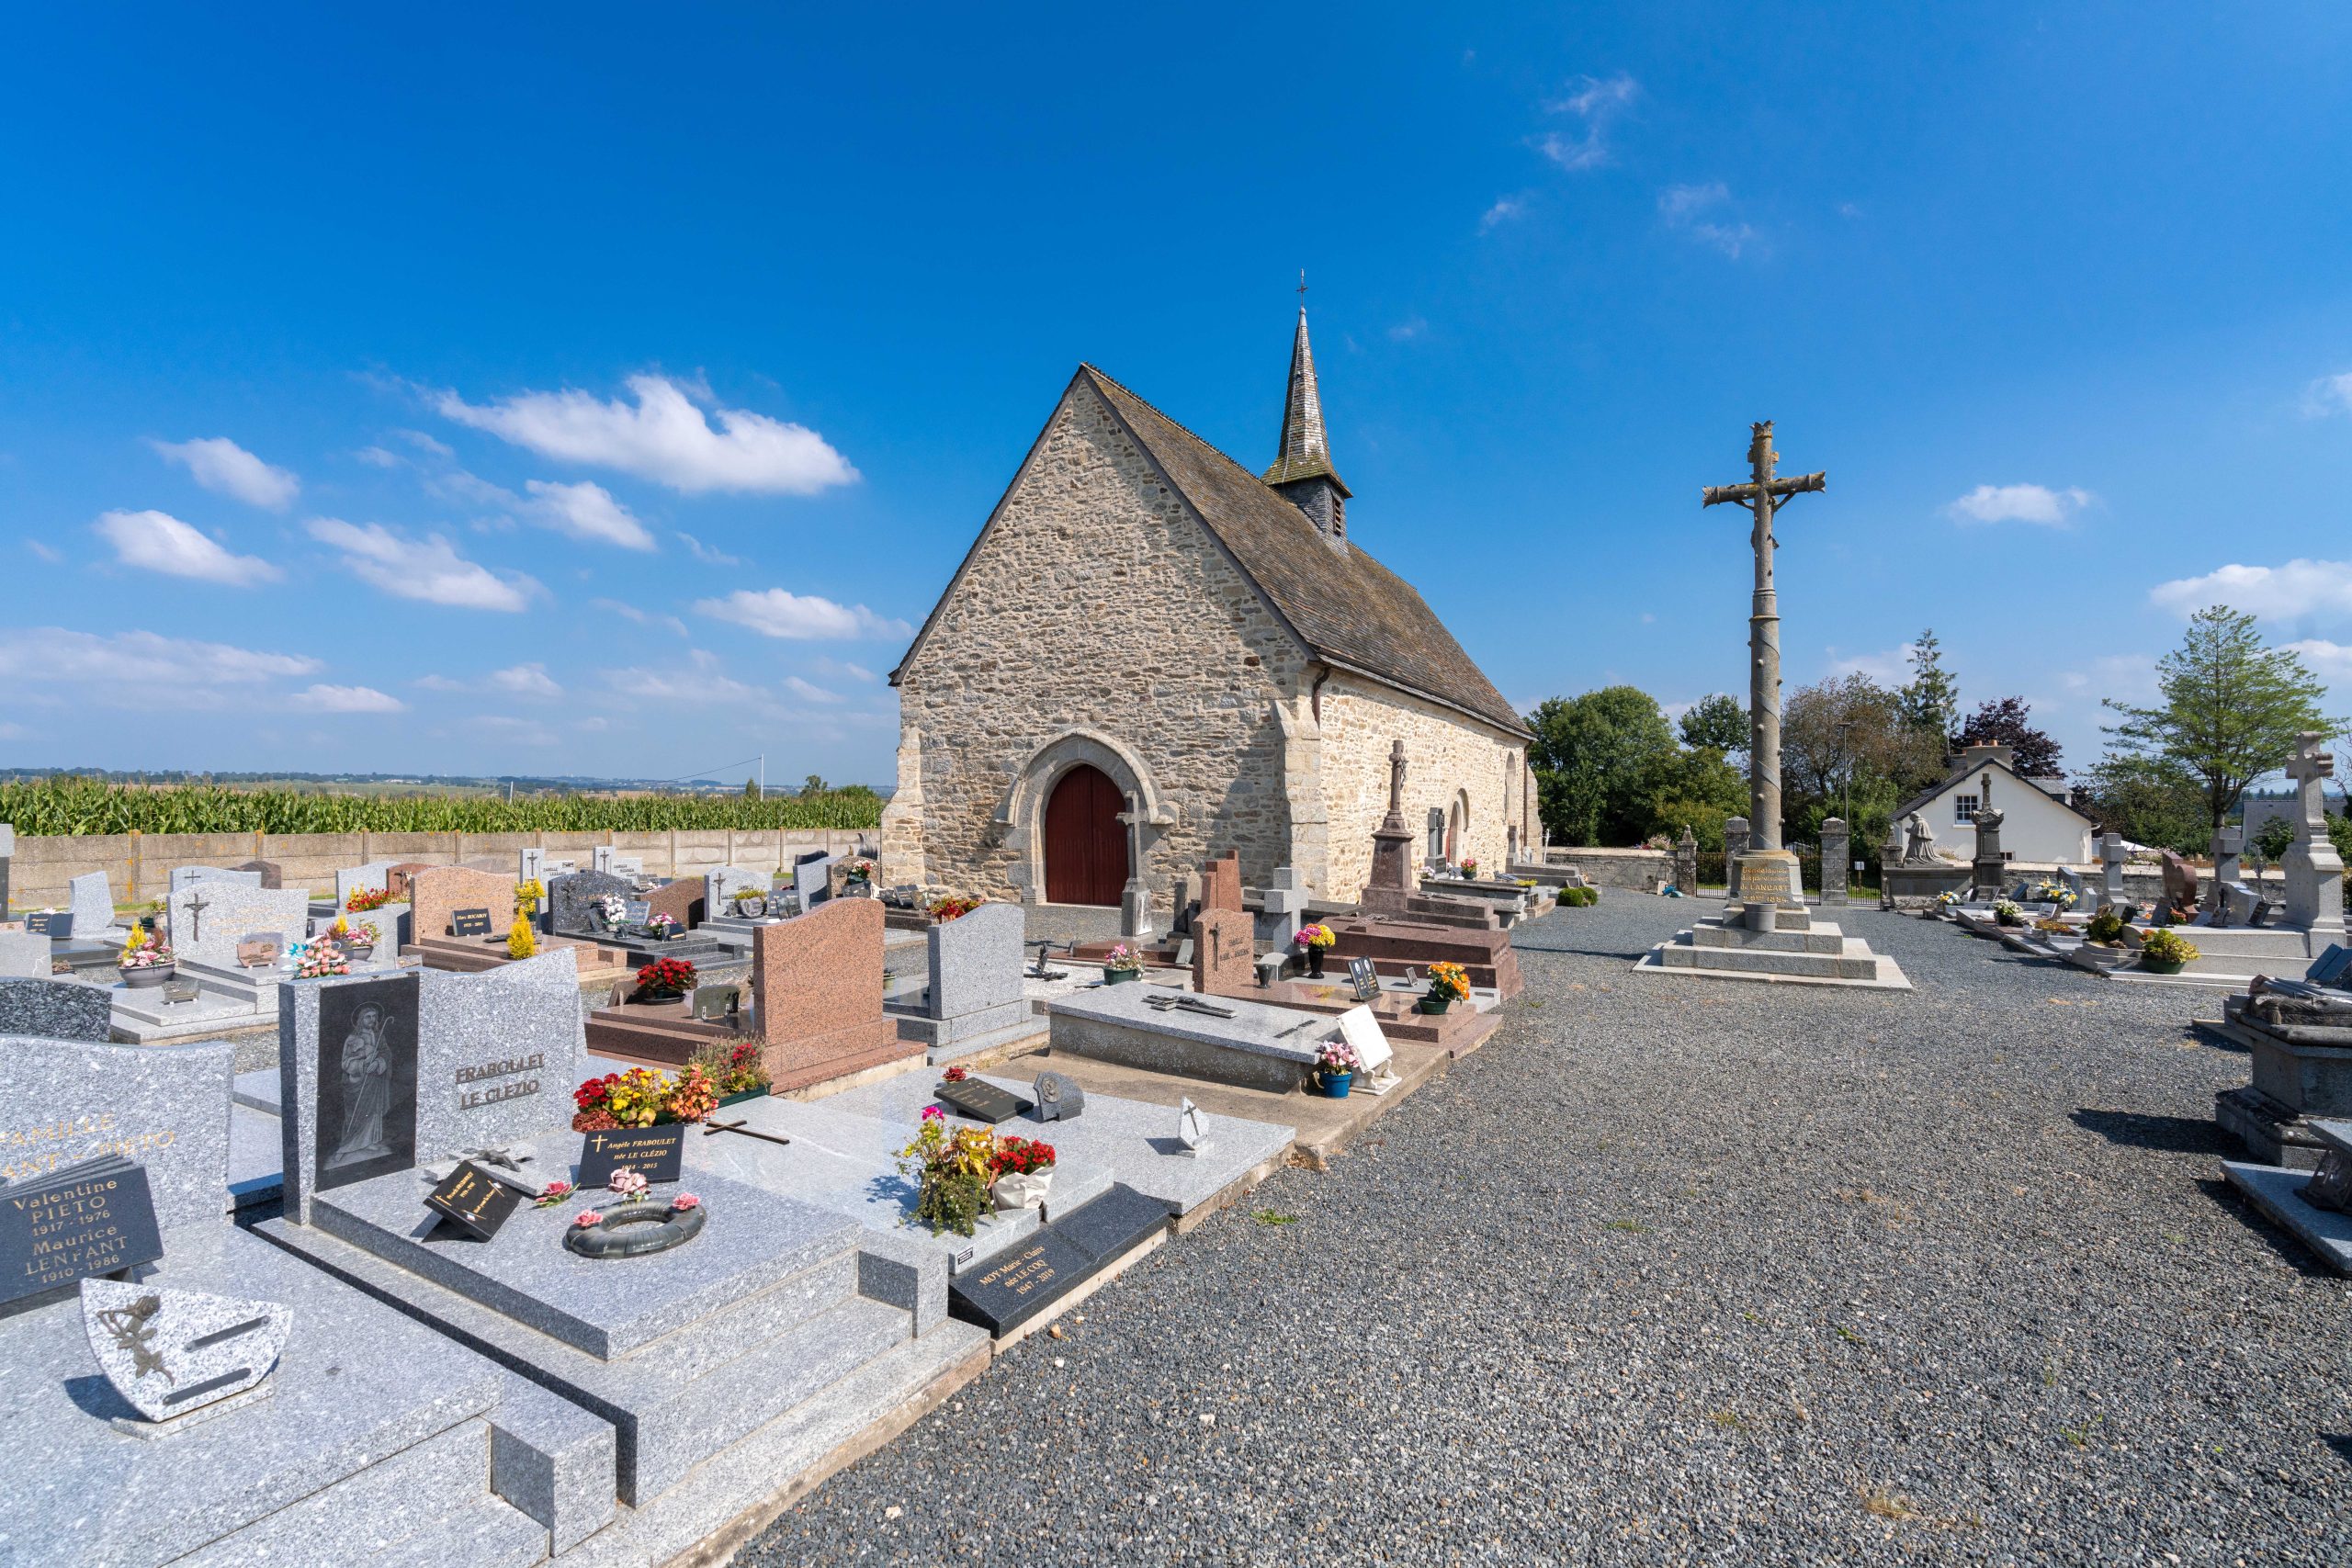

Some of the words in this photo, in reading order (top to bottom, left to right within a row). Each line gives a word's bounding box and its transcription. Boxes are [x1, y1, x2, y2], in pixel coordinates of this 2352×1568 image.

[456, 1054, 545, 1084] FRABOULET
[461, 1091, 480, 1110] LE
[97, 1131, 175, 1157] PIETO
[632, 1138, 676, 1147] FRABOULET
[640, 1149, 667, 1158] CLÉZIO
[14, 1180, 118, 1211] Valentine
[31, 1196, 106, 1224] PIETO
[32, 1221, 64, 1236] 1917
[79, 1210, 110, 1225] 1976
[33, 1226, 118, 1257] Maurice
[25, 1236, 128, 1276] LENFANT
[42, 1267, 74, 1283] 1910
[88, 1255, 119, 1270] 1986
[978, 1270, 1001, 1286] MOY
[999, 1258, 1023, 1274] Marie
[1023, 1246, 1046, 1259] Claire
[1004, 1275, 1019, 1288] née
[1015, 1269, 1030, 1280] LE
[1027, 1259, 1048, 1272] COQ
[1016, 1280, 1035, 1295] 1947
[1036, 1269, 1056, 1282] 2019
